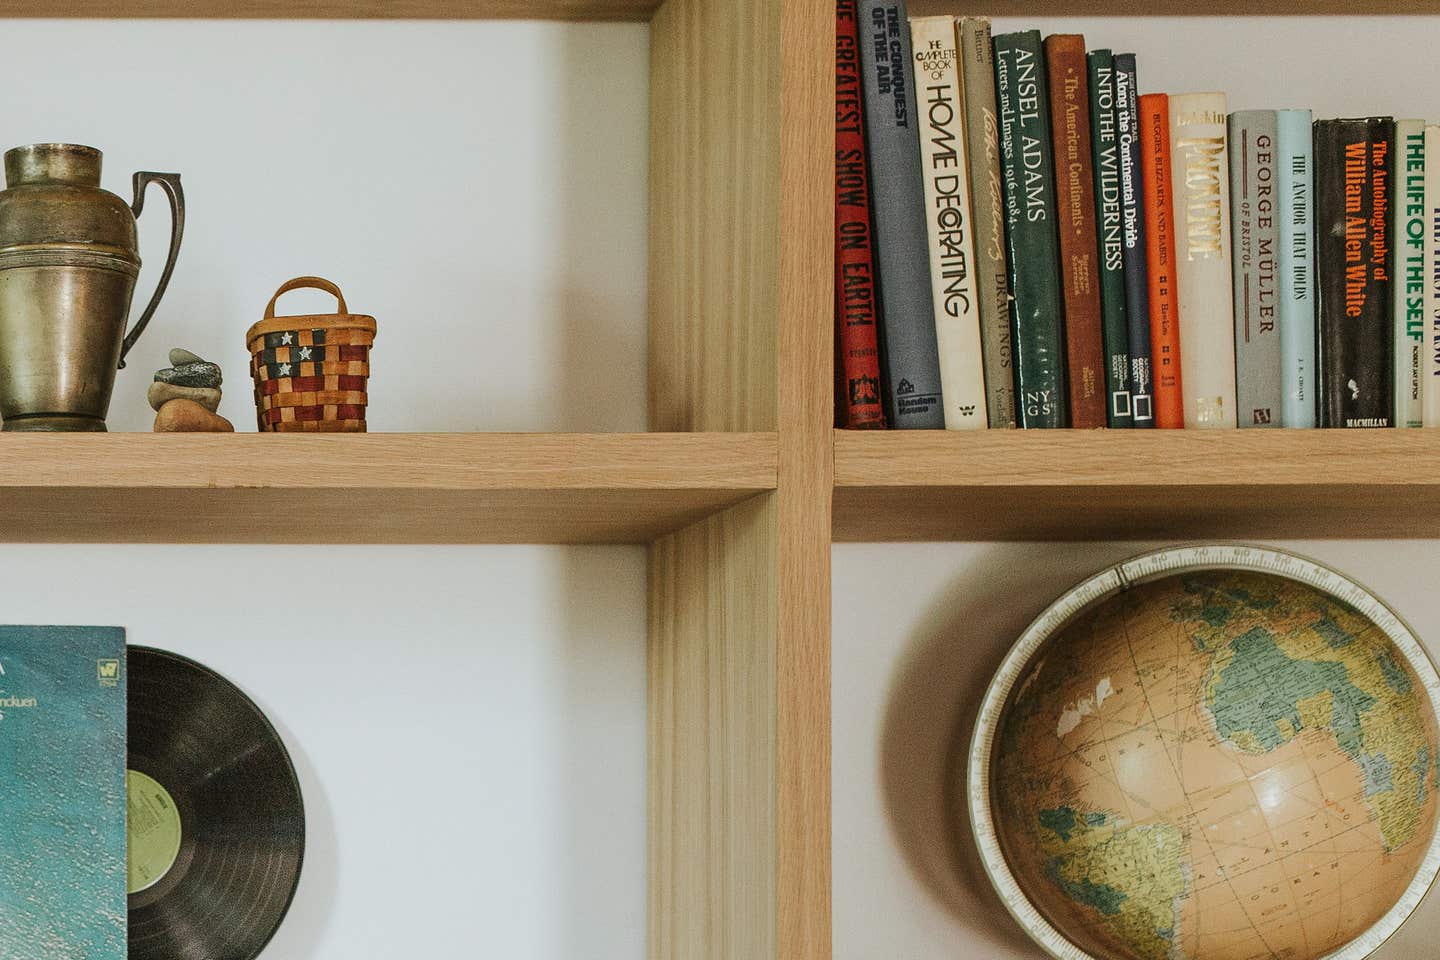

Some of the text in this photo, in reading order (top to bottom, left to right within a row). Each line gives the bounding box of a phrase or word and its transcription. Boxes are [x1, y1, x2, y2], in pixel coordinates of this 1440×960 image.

[837, 35, 861, 136] GREATEST
[872, 7, 890, 94] OF THE AIR
[887, 6, 908, 129] THE CONQUEST
[923, 60, 951, 71] BOOK
[931, 71, 944, 80] OF
[997, 50, 1010, 90] Letters
[1001, 93, 1015, 115] and
[1001, 117, 1016, 159] Images
[1015, 48, 1046, 222] ANSEL ADAMS
[1064, 76, 1084, 227] The American Continents
[836, 149, 865, 207] SHOW
[927, 84, 970, 318] HOME DECORATING
[1097, 67, 1122, 271] INTO THE WILDERNESS
[1115, 70, 1139, 248] Along the Continental Divide
[839, 222, 868, 253] ON
[1241, 202, 1251, 269] OF BRISTOL
[1256, 135, 1278, 335] GEORGE MÜLLER
[1292, 154, 1307, 301] THE ANCHOR THAT HOLDS
[1345, 141, 1367, 317] William Allen White
[1370, 141, 1388, 281] The Autobiography of
[1406, 131, 1425, 343] THE LIFE OF THE SELF
[841, 263, 872, 327] EARTH
[995, 272, 1010, 369] DRAWINGS
[1346, 418, 1388, 427] MACMILLAN
